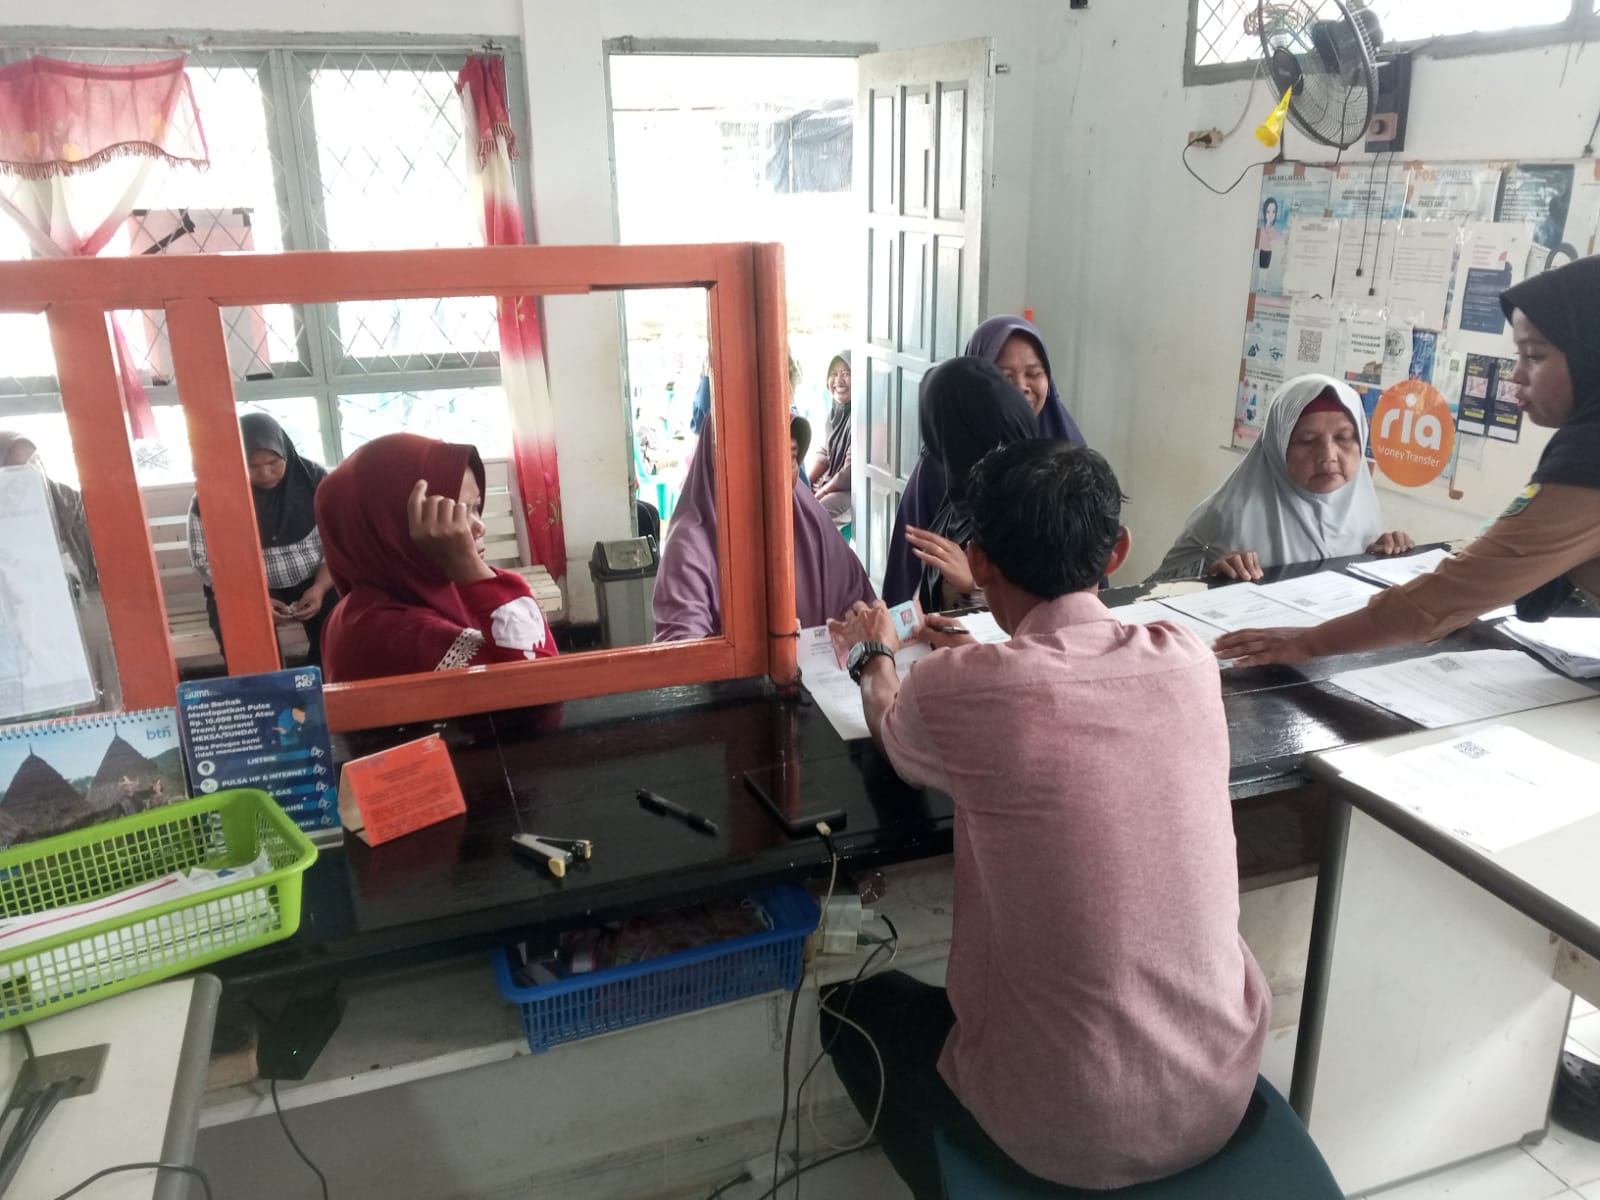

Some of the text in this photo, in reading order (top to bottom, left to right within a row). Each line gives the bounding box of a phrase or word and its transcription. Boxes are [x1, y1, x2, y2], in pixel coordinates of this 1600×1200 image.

[1380, 392, 1442, 451] ria
[1378, 444, 1441, 467] Money Transfer
[187, 698, 241, 712] Anda Berhak
[188, 702, 271, 720] Mendapatkan Pulsa
[255, 709, 275, 718] Atau
[145, 725, 172, 741] btn
[190, 725, 216, 735] Premi
[222, 775, 248, 787] PULSA
[249, 773, 260, 783] HP
[269, 768, 308, 780] INTERNET
[275, 788, 292, 796] GAS
